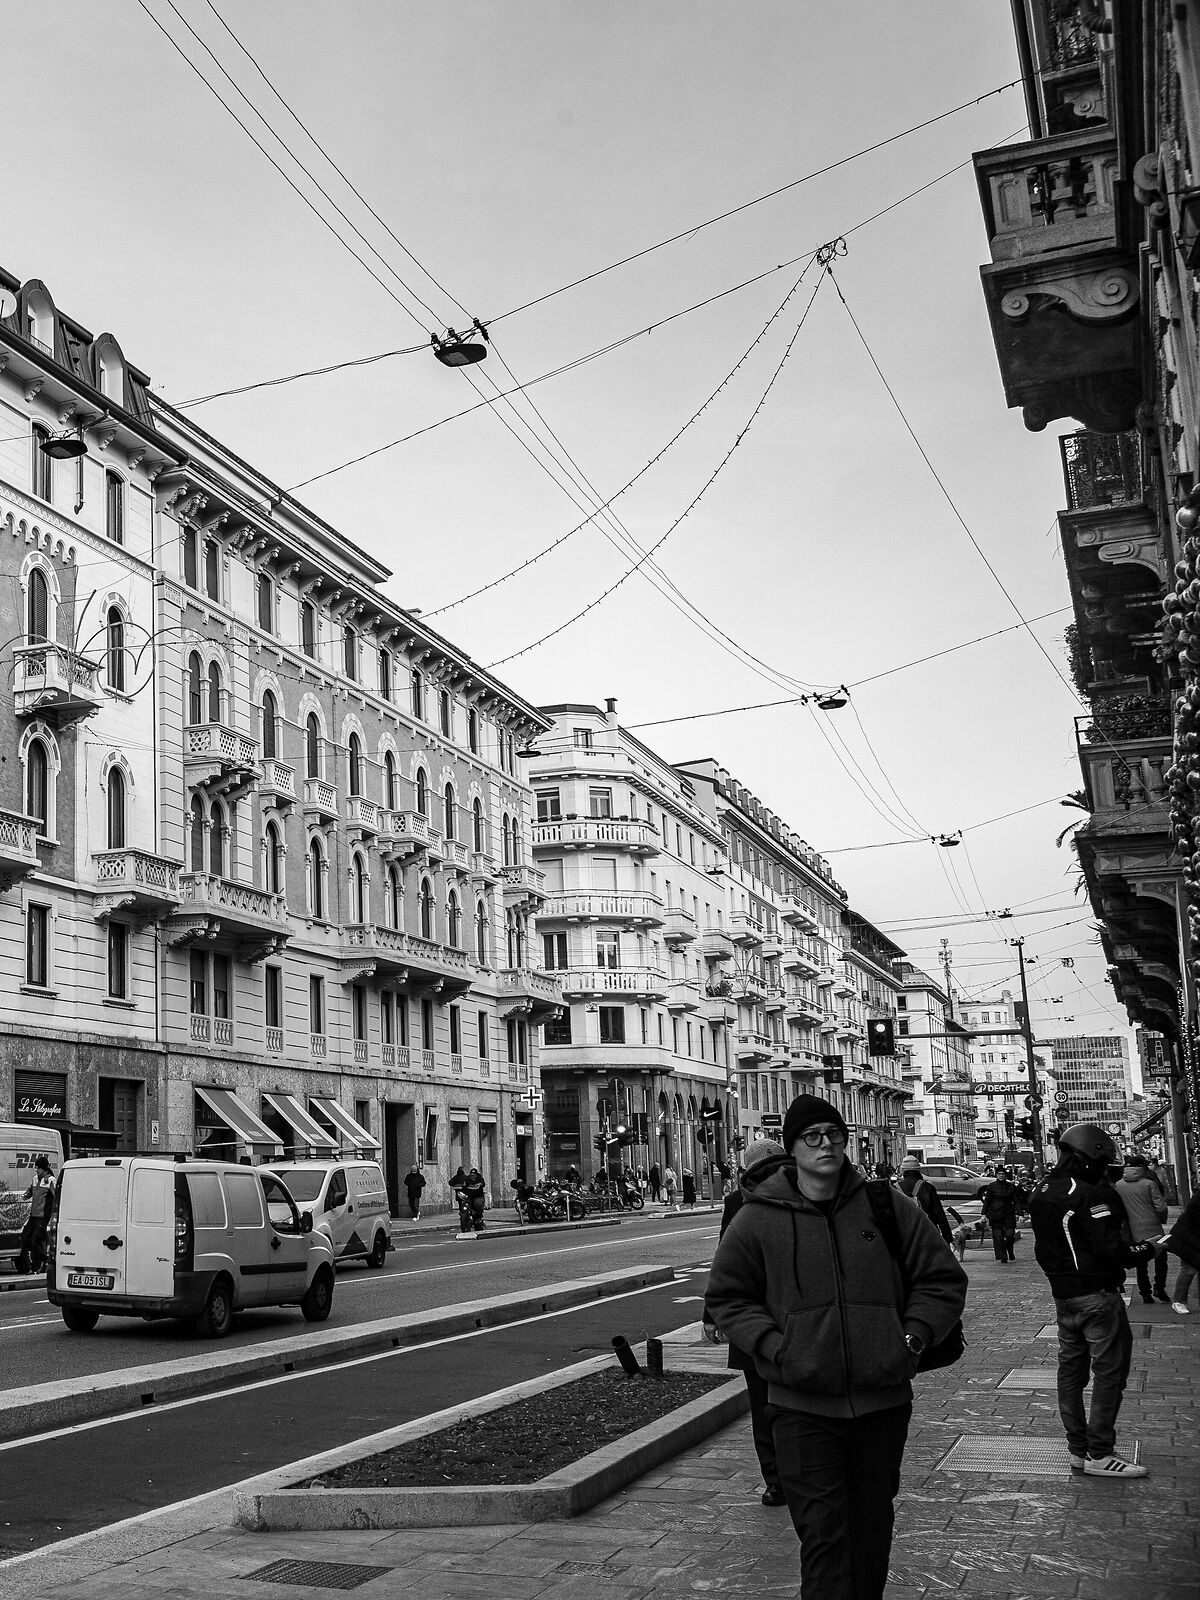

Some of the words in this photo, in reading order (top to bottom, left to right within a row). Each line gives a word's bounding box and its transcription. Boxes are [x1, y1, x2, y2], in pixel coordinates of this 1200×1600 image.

[1057, 1092, 1065, 1100] 30
[18, 1097, 30, 1114] La
[30, 1098, 61, 1117] Stilografica
[73, 1276, 82, 1285] EA
[84, 1276, 108, 1287] 031SL
